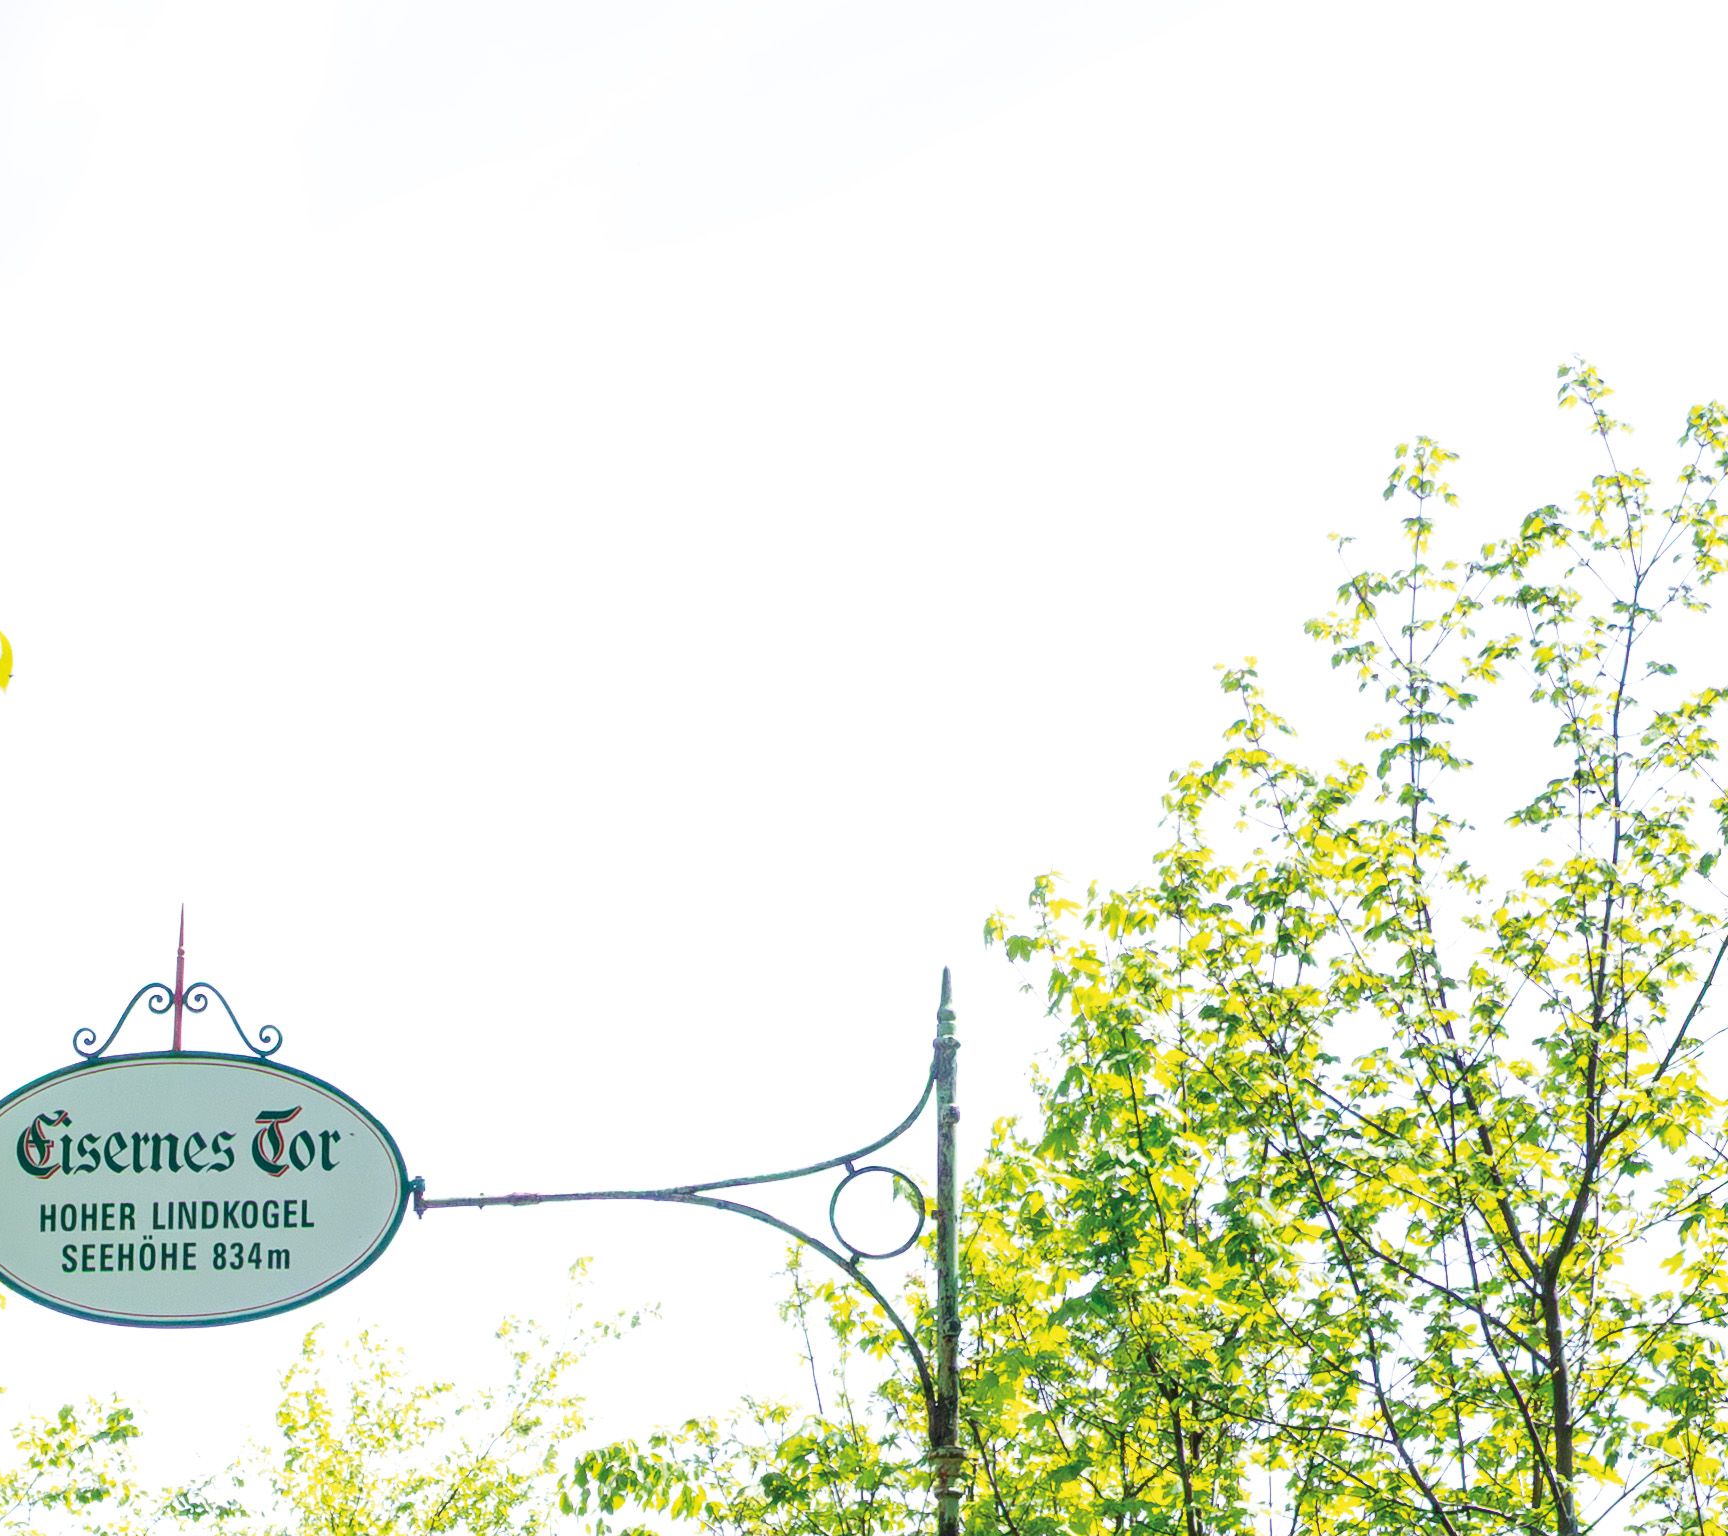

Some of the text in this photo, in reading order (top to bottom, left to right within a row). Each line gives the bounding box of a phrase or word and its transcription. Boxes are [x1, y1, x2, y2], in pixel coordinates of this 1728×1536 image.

[16, 1105, 341, 1180] Eisernes Tor
[40, 1199, 315, 1232] HOHER LINDKOGEL
[61, 1235, 197, 1272] SEEHÖHE
